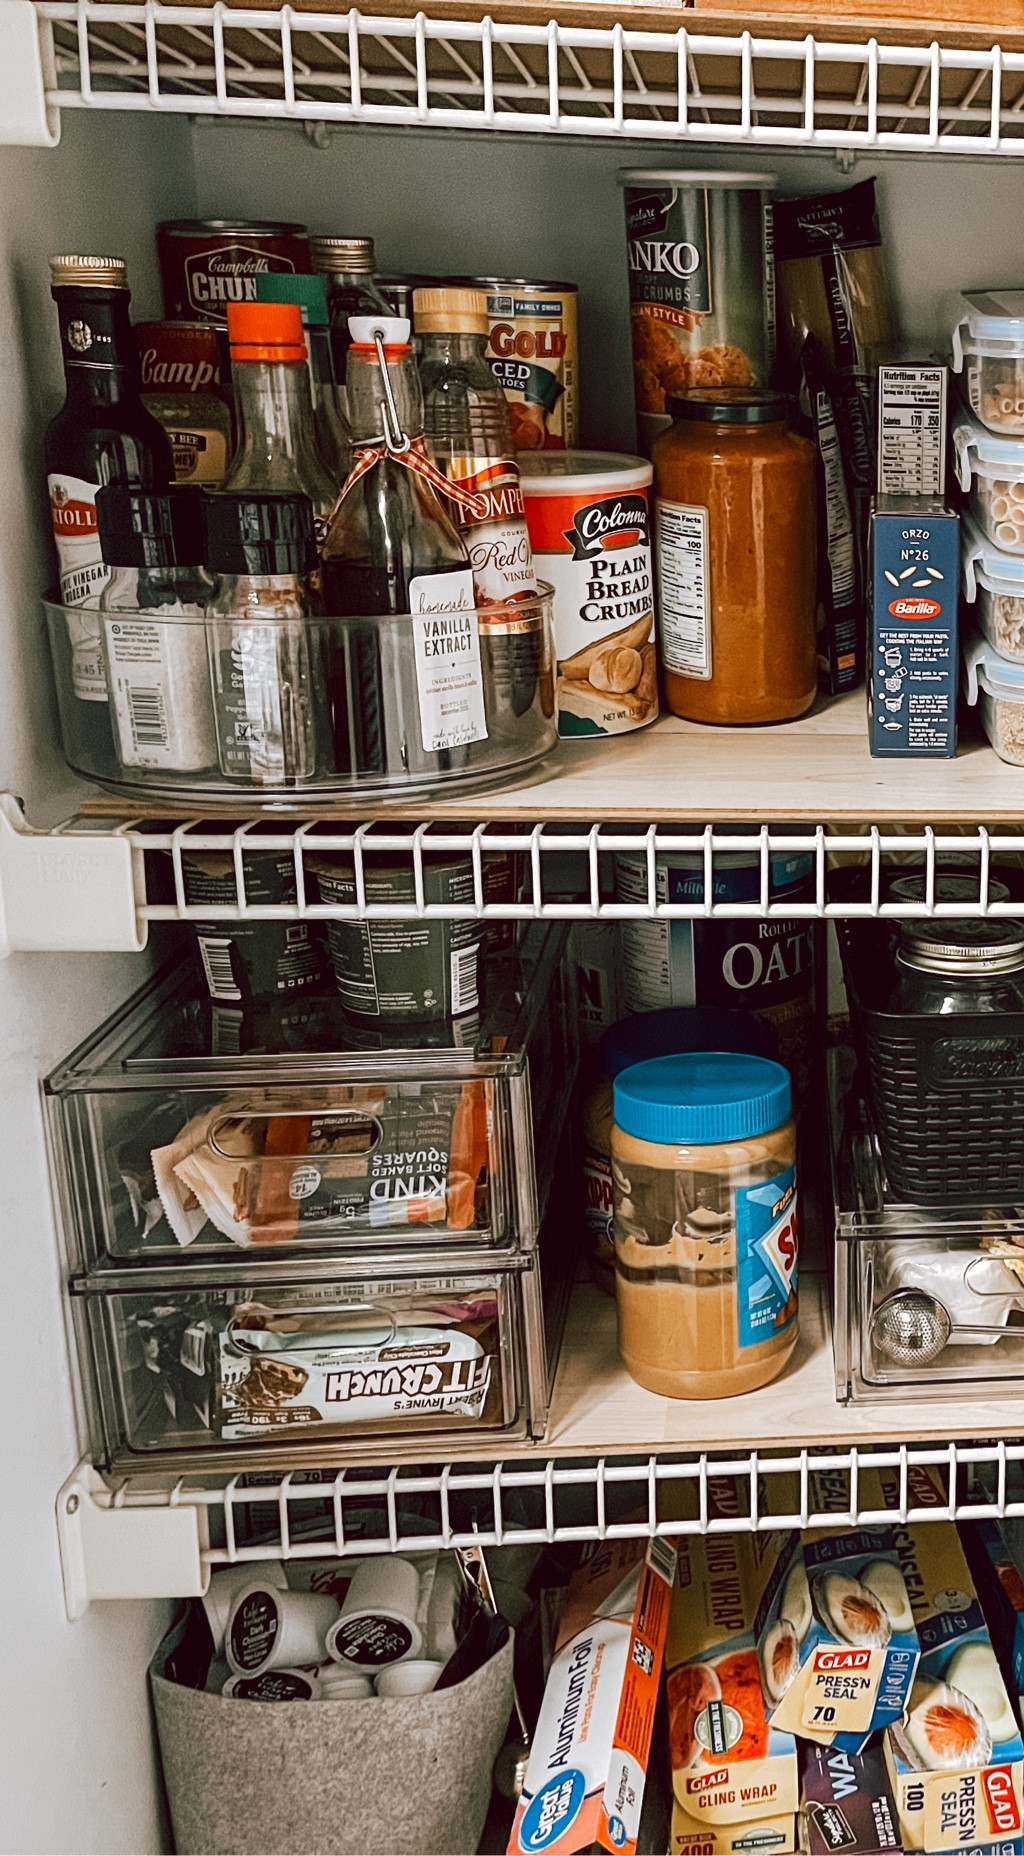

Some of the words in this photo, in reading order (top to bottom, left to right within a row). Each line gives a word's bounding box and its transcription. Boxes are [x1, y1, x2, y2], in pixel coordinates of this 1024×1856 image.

[643, 285, 692, 301] CRUMBS
[515, 303, 541, 312] FAMILY
[541, 303, 561, 312] OWNED
[652, 308, 685, 326] STYLE
[489, 323, 568, 358] GOLD
[884, 371, 916, 381] Nutrition
[920, 372, 940, 382] Facts
[883, 417, 901, 426] Calories
[911, 415, 922, 426] 170
[582, 502, 646, 538] Colonna
[682, 515, 702, 524] Facts
[687, 540, 702, 549] 100
[901, 529, 931, 541] ORZO
[469, 541, 516, 572] Red
[590, 554, 647, 580] PLAIN
[72, 565, 110, 588] VINEGAR
[586, 577, 650, 601] BREAD
[579, 594, 654, 623] CRUMBS
[894, 602, 937, 615] Barilla
[423, 617, 471, 638] VANILLA
[424, 634, 472, 657] EXTRACT
[431, 673, 472, 685] INGREDIENTS
[440, 699, 468, 710] BOTTLED
[603, 710, 615, 721] NET
[373, 1147, 448, 1166] SQUARES
[372, 1164, 414, 1176] BAKED
[417, 1163, 447, 1175] SOFT
[295, 1183, 308, 1193] 14
[369, 1175, 447, 1201] KIND
[333, 1196, 364, 1205] PROTEIN
[326, 1362, 443, 1403] CRUNCH
[442, 1354, 490, 1394] FIT
[394, 1397, 445, 1411] IRVINE'S
[252, 1415, 270, 1424] 190
[303, 1472, 320, 1482] 70
[704, 1535, 737, 1573] LING
[710, 1577, 745, 1631] WRAP
[817, 1653, 869, 1669] GLAD
[816, 1675, 870, 1688] PRESS'N
[548, 1669, 587, 1769] Aluminum
[568, 1637, 593, 1675] Foil
[823, 1688, 857, 1699] SEAL
[813, 1706, 836, 1721] 70
[615, 1765, 629, 1813] Aluminum
[690, 1770, 727, 1792] GLAD
[554, 1778, 575, 1820] Value
[626, 1786, 635, 1808] Foil
[699, 1790, 735, 1808] CLING
[740, 1784, 777, 1802] WRAP
[906, 1782, 925, 1811] 100
[987, 1770, 1014, 1829] GLAD
[530, 1784, 560, 1845] Great
[941, 1792, 957, 1833] SEAL
[959, 1776, 975, 1841] PRESS'N
